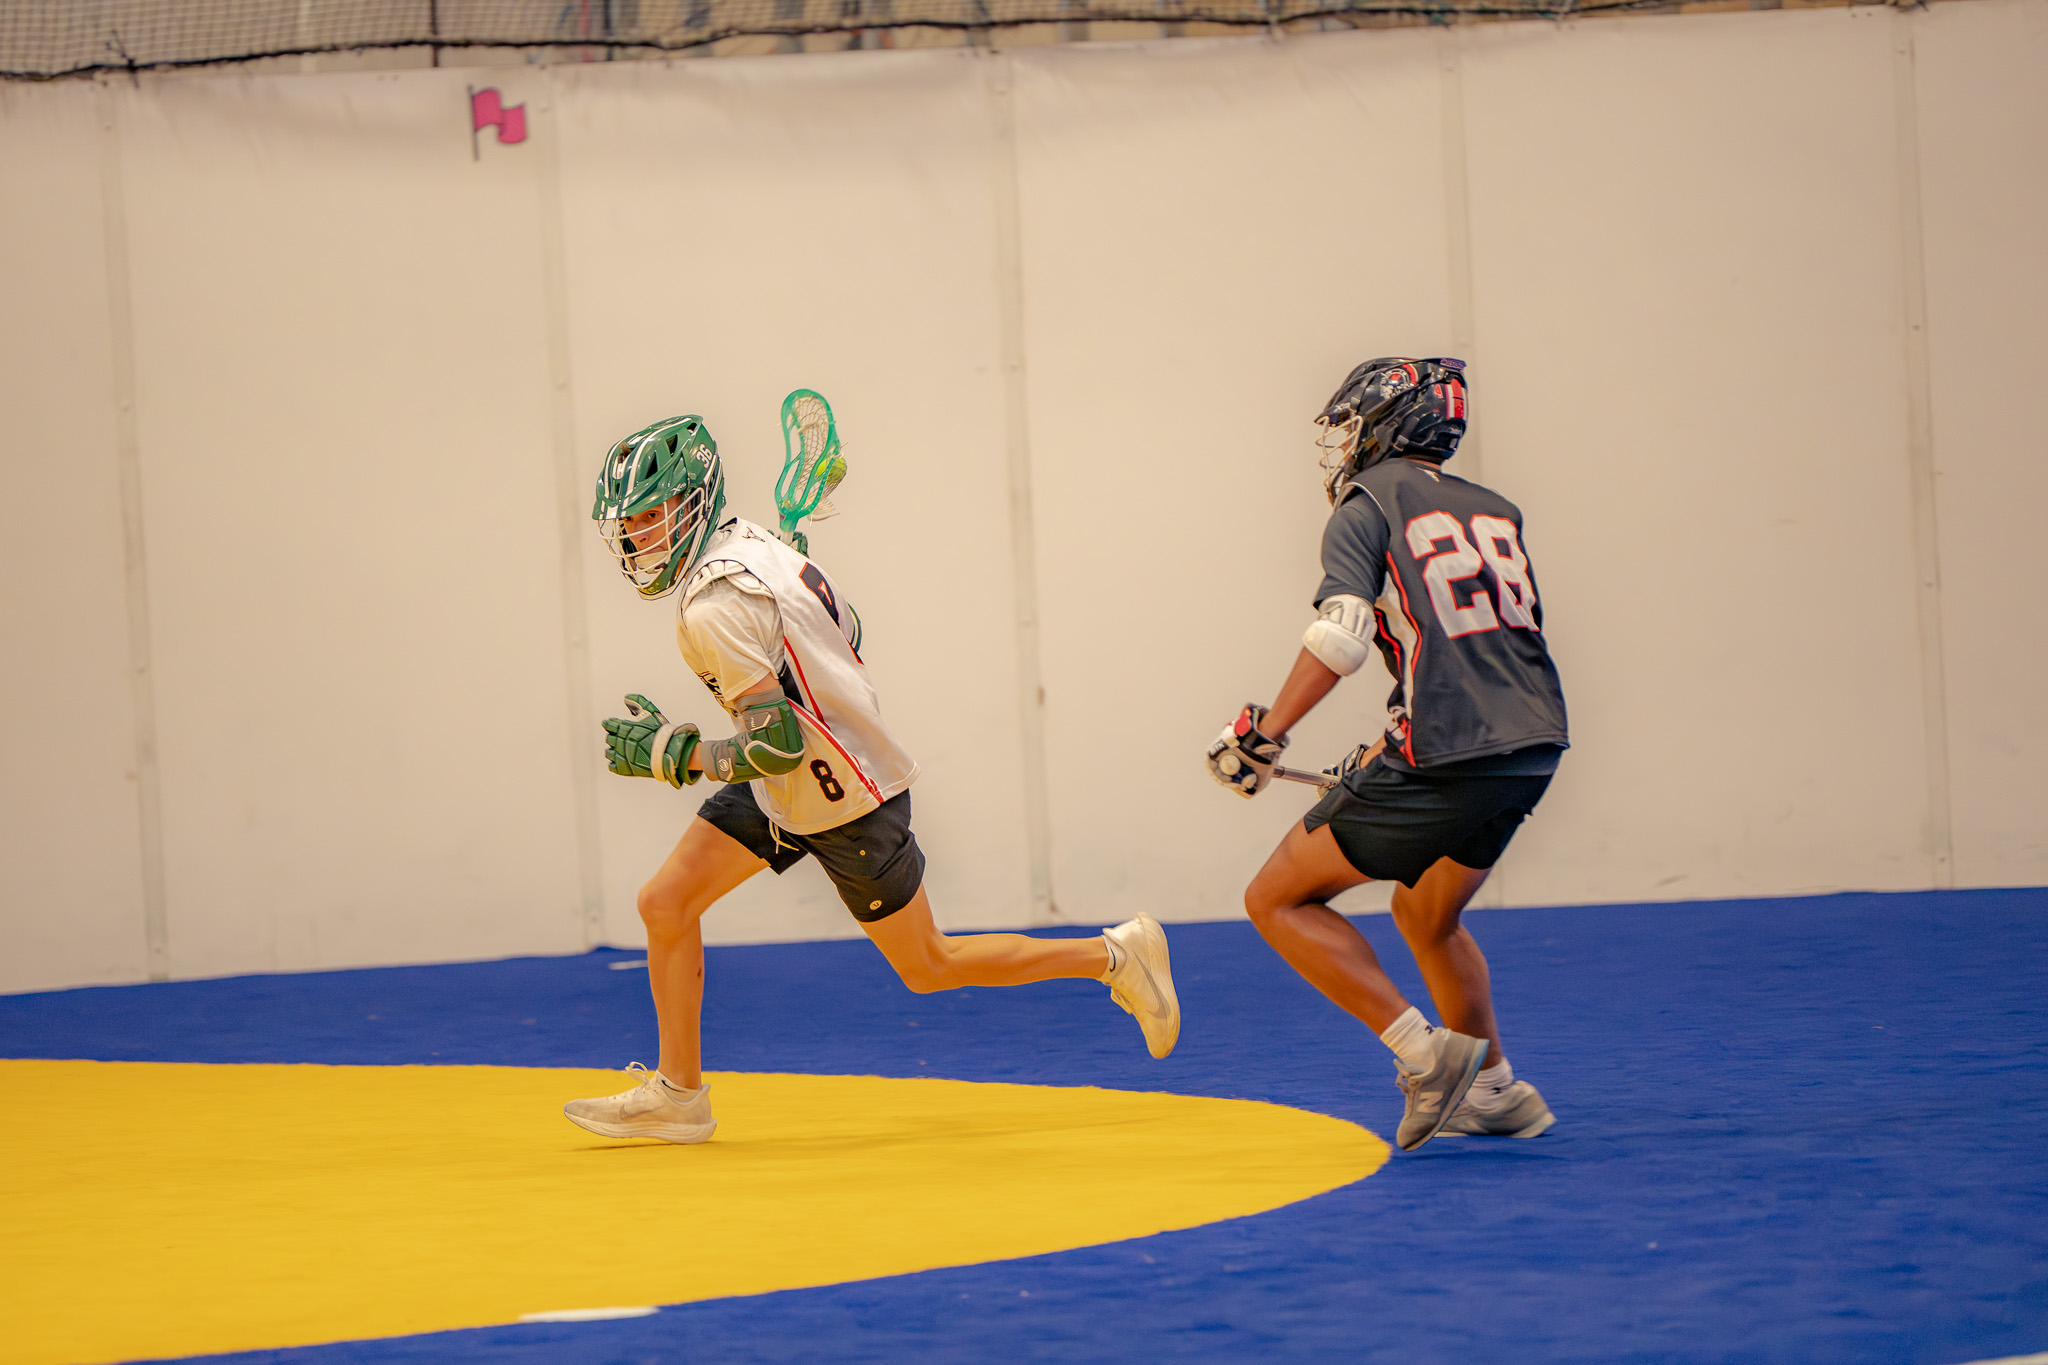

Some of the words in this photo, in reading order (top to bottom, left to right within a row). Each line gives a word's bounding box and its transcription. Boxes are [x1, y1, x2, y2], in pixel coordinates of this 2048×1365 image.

[696, 443, 713, 469] 36
[1404, 510, 1540, 639] 28
[809, 758, 845, 803] 8
